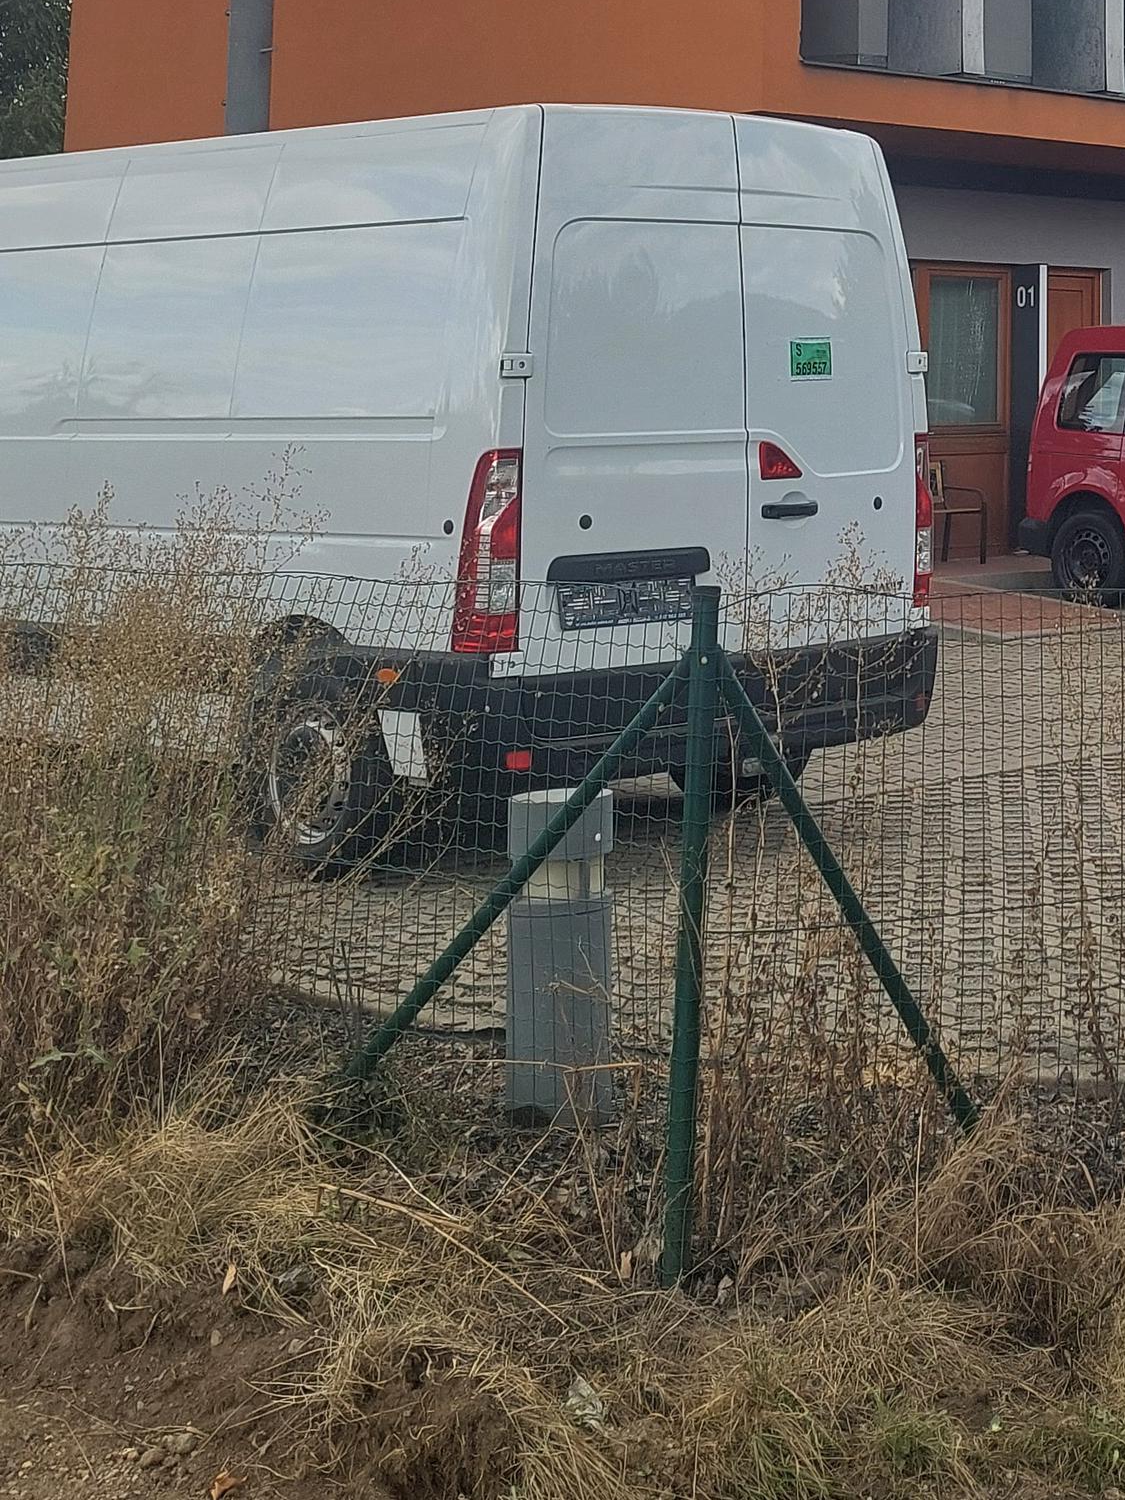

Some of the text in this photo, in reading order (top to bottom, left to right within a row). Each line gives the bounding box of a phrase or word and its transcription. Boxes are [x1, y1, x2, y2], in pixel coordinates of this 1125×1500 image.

[1016, 285, 1035, 308] 01
[795, 343, 803, 357] S
[795, 361, 828, 376] 569557
[593, 558, 676, 576] MASTER
